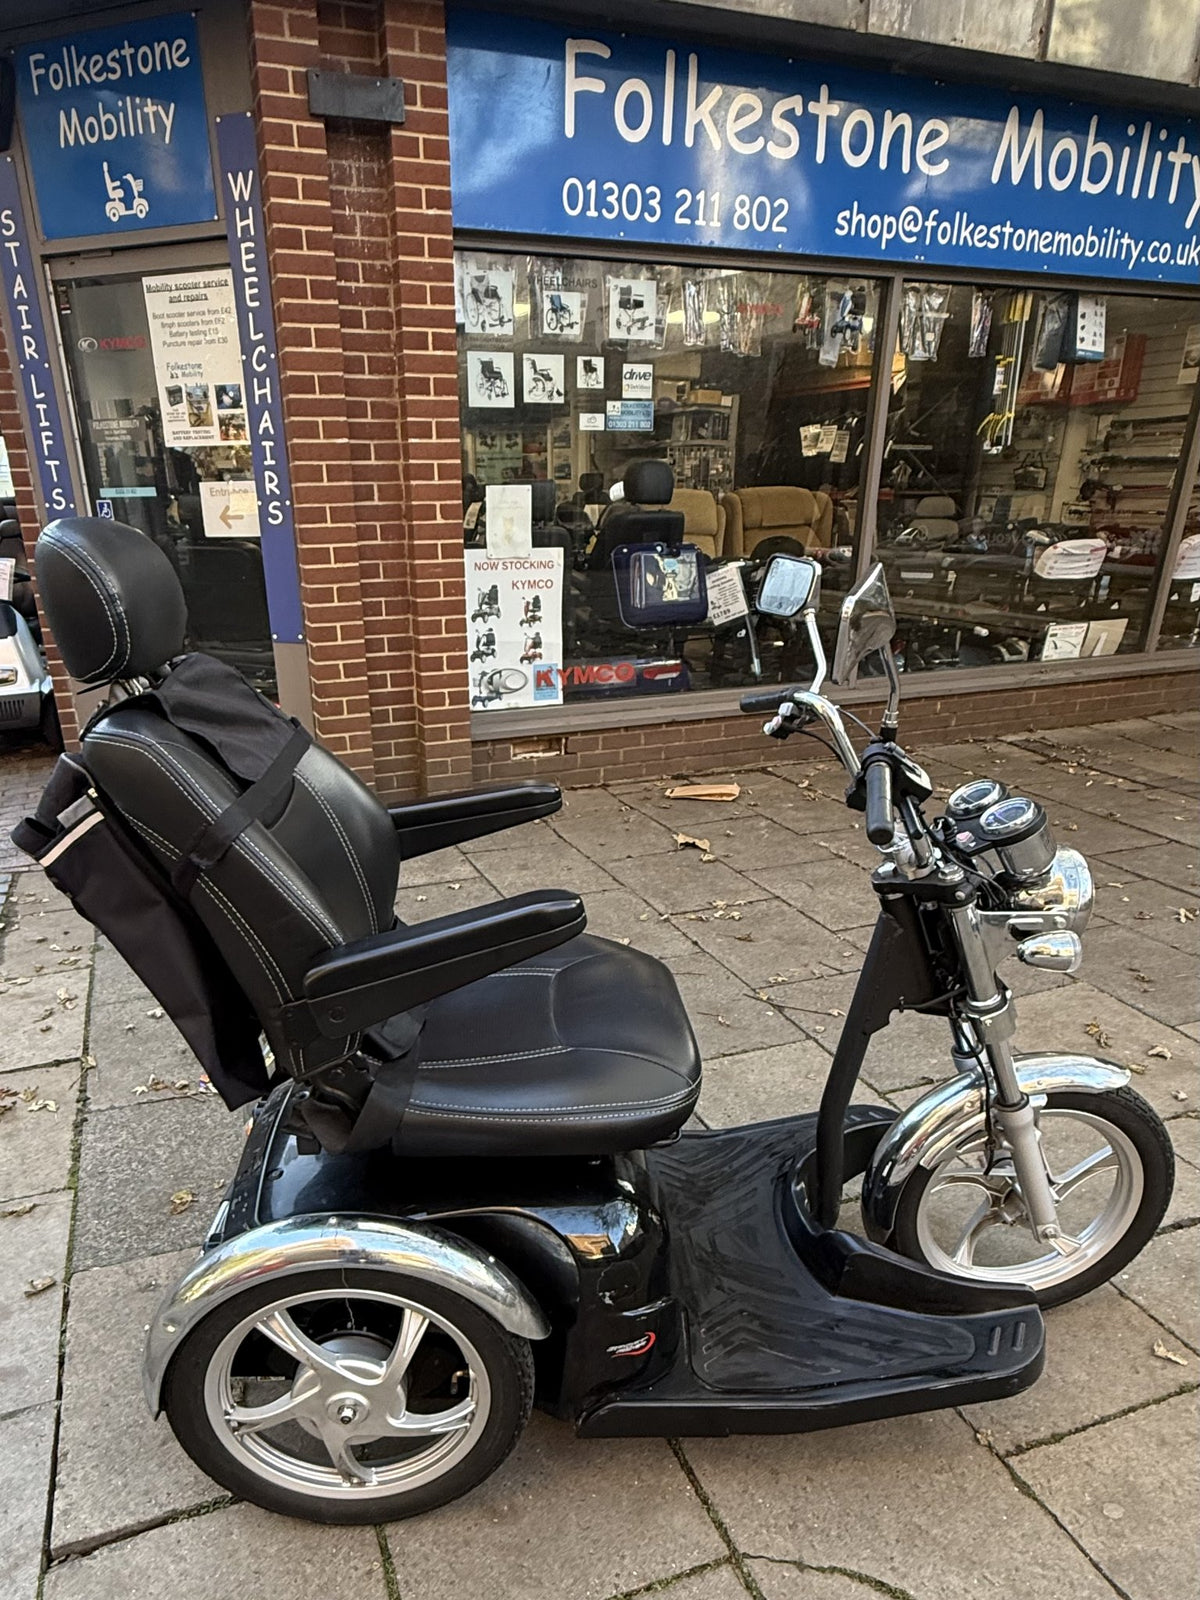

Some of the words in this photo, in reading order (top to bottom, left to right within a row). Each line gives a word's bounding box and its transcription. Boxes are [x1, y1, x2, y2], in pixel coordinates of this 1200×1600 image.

[29, 37, 191, 96] Folkestone
[58, 96, 175, 148] Mobility
[563, 37, 951, 177] Folkestone
[991, 104, 1200, 230] Mobility
[562, 176, 663, 224] 01303
[674, 188, 722, 229] 211
[732, 194, 789, 235] 802
[834, 201, 1200, 270] shop@folkestonemobility.co.uk
[1, 209, 39, 361] STAIR
[146, 283, 173, 293] Mobility
[174, 281, 200, 290] scooter
[203, 278, 229, 287] service
[527, 274, 598, 289] WHEELCHAIRS
[169, 294, 181, 303] and
[183, 293, 208, 302] repairs
[189, 328, 207, 337] testing
[162, 340, 186, 348] Puncture
[227, 169, 283, 526] WHEELCHAIRS
[166, 361, 202, 371] Folkestone
[181, 370, 203, 378] Mobility
[623, 368, 651, 381] drive
[30, 373, 67, 512] LIFTS
[474, 561, 499, 571] NOW
[501, 560, 555, 570] STOCKING
[511, 579, 554, 590] KYMCO
[536, 662, 636, 689] KYMCO
